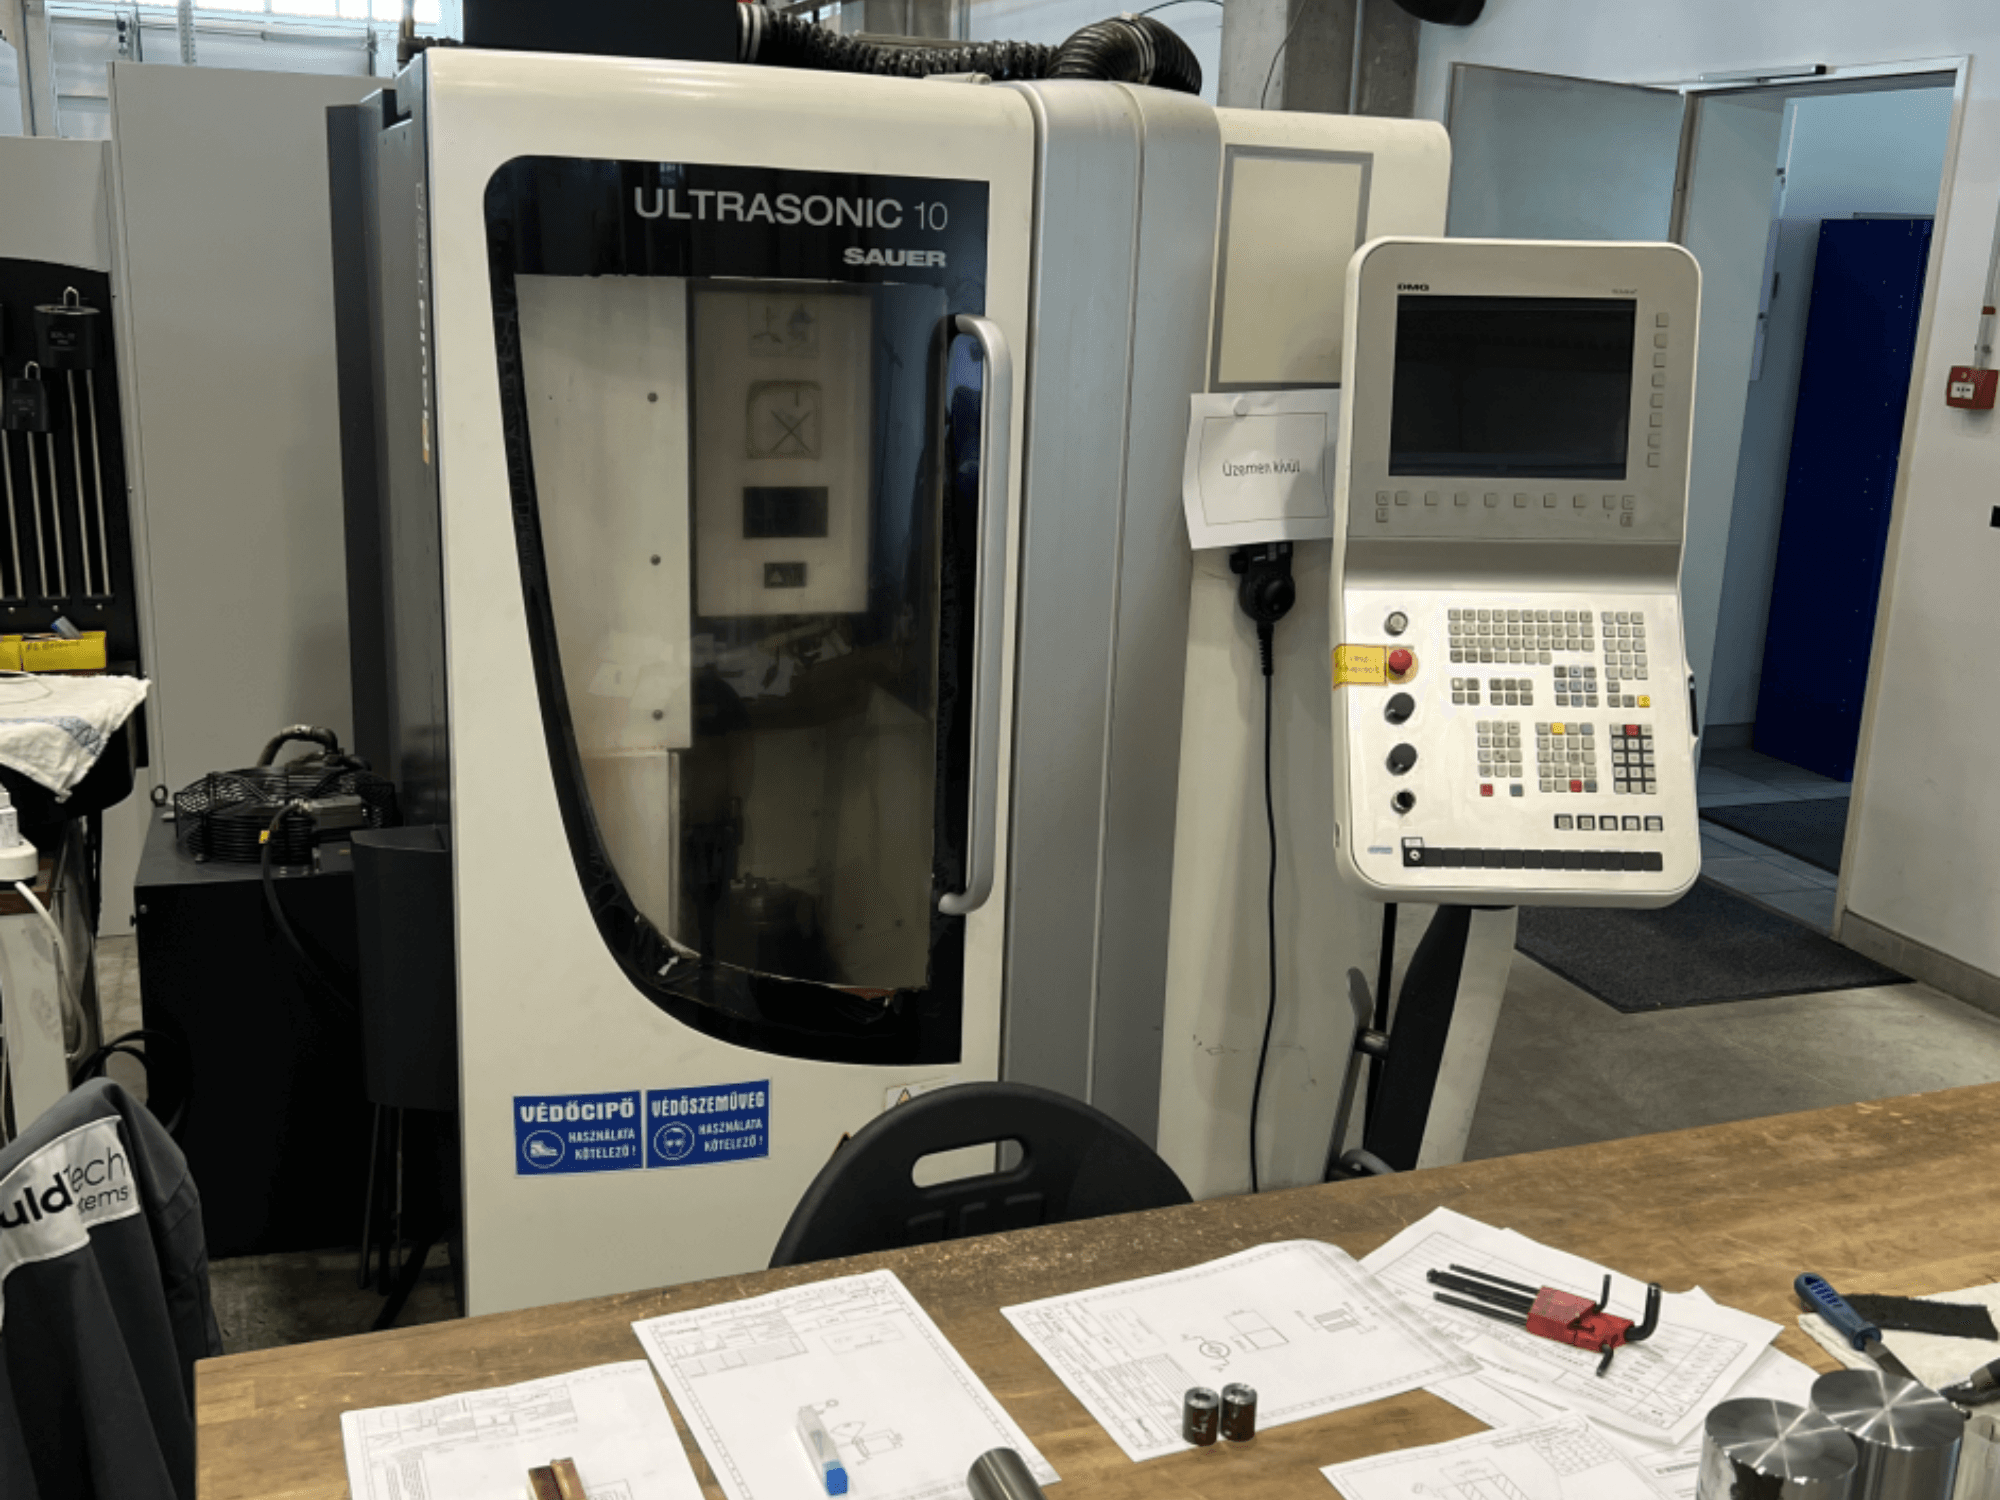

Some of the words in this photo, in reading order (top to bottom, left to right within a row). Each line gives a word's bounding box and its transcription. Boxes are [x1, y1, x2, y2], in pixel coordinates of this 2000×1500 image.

[634, 186, 903, 229] ULTRASONIC
[913, 201, 949, 231] 10
[843, 247, 948, 268] SAUER
[1397, 283, 1430, 292] DMG
[1222, 460, 1272, 478] Üzemen
[520, 1098, 635, 1123] VÉDŐCIPŐ
[568, 1127, 636, 1144] HASZNÁLATA
[697, 1117, 764, 1136] HASZNÁLATA
[574, 1143, 630, 1161] KÖTELEZŐ
[703, 1133, 758, 1153] KÖTELEZŐ
